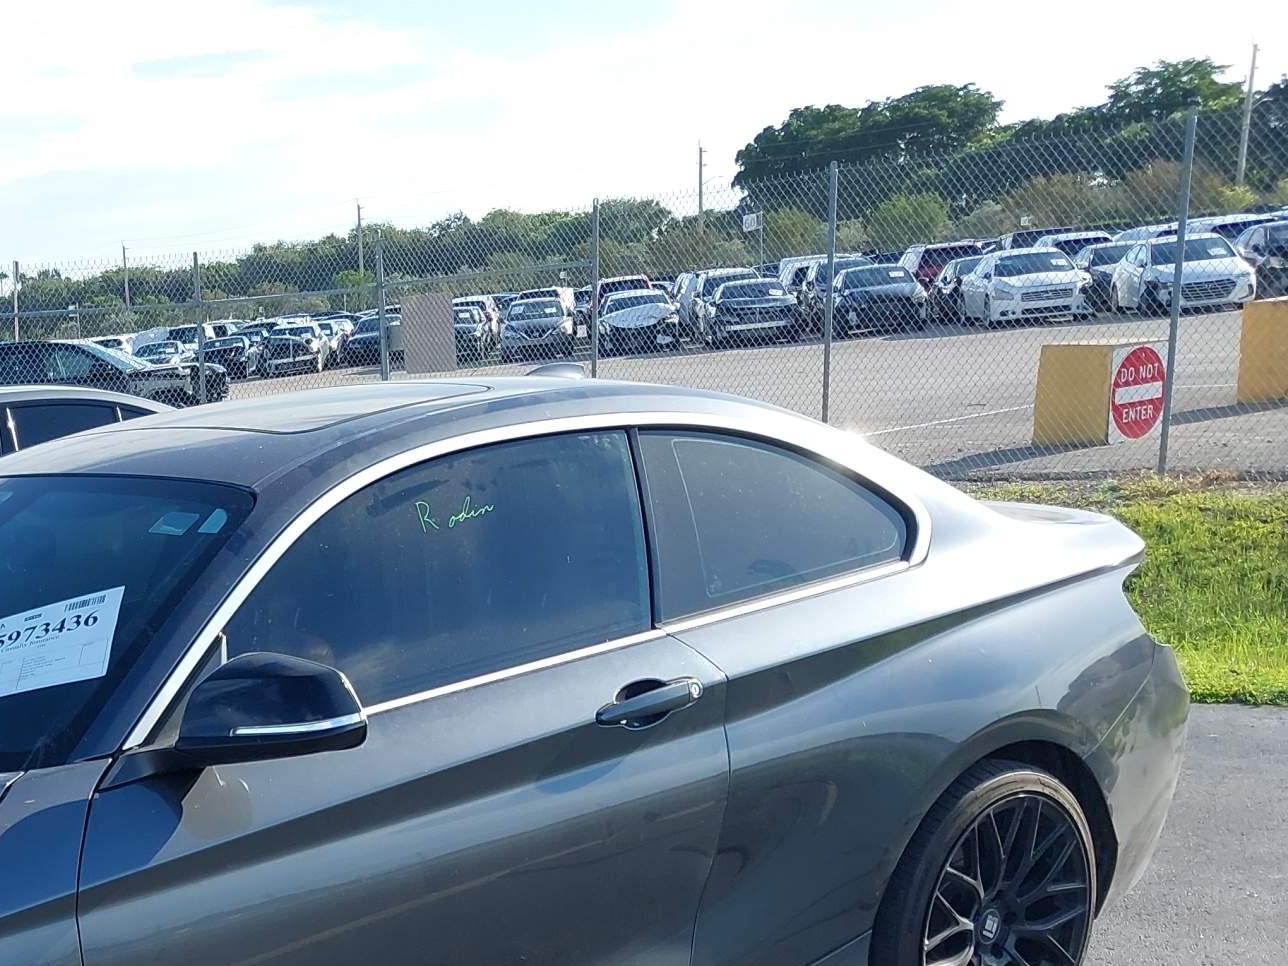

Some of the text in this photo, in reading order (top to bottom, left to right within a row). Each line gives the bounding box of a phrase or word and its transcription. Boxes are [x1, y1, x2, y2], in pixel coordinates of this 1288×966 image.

[1120, 363, 1159, 383] DO NOT
[1122, 404, 1154, 424] ENTER
